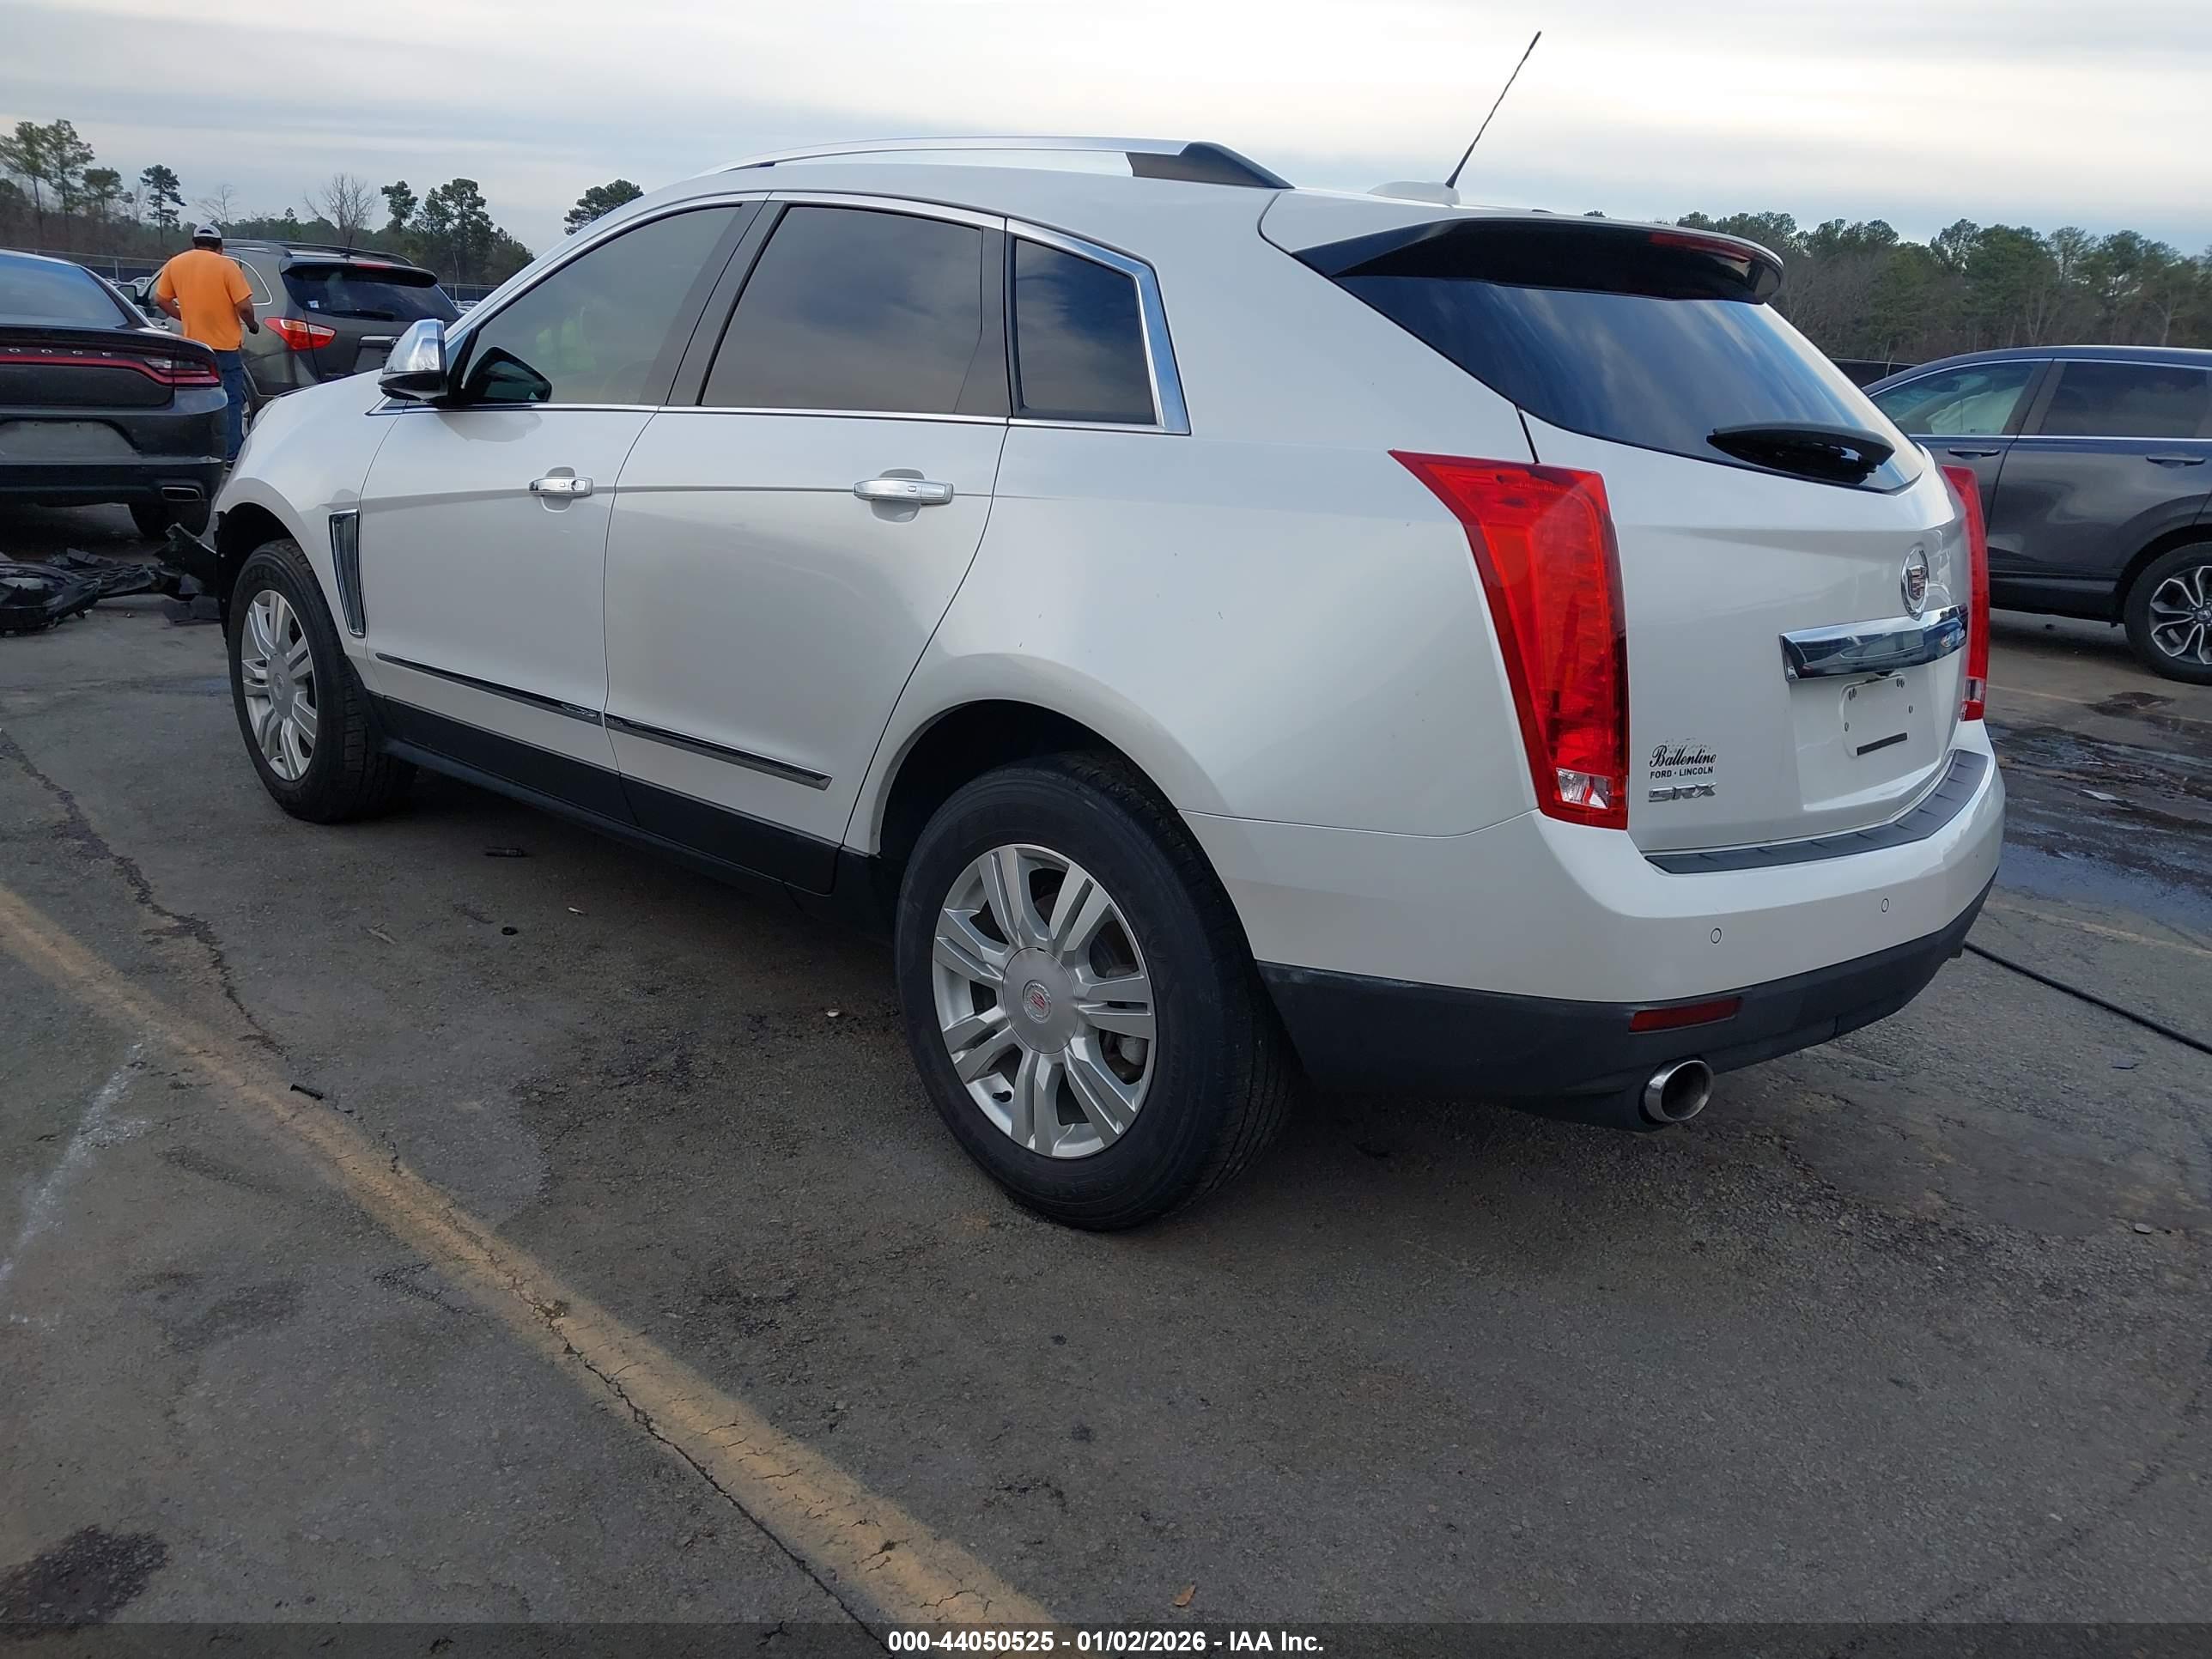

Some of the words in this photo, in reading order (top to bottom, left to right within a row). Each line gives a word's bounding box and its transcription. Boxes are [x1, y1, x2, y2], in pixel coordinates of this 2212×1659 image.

[8, 348, 112, 357] ODGE
[1649, 744, 1717, 767] Ballentine
[1650, 769, 1672, 780] FORD
[1679, 766, 1714, 776] LINCOLN
[1648, 782, 1717, 803] SRX
